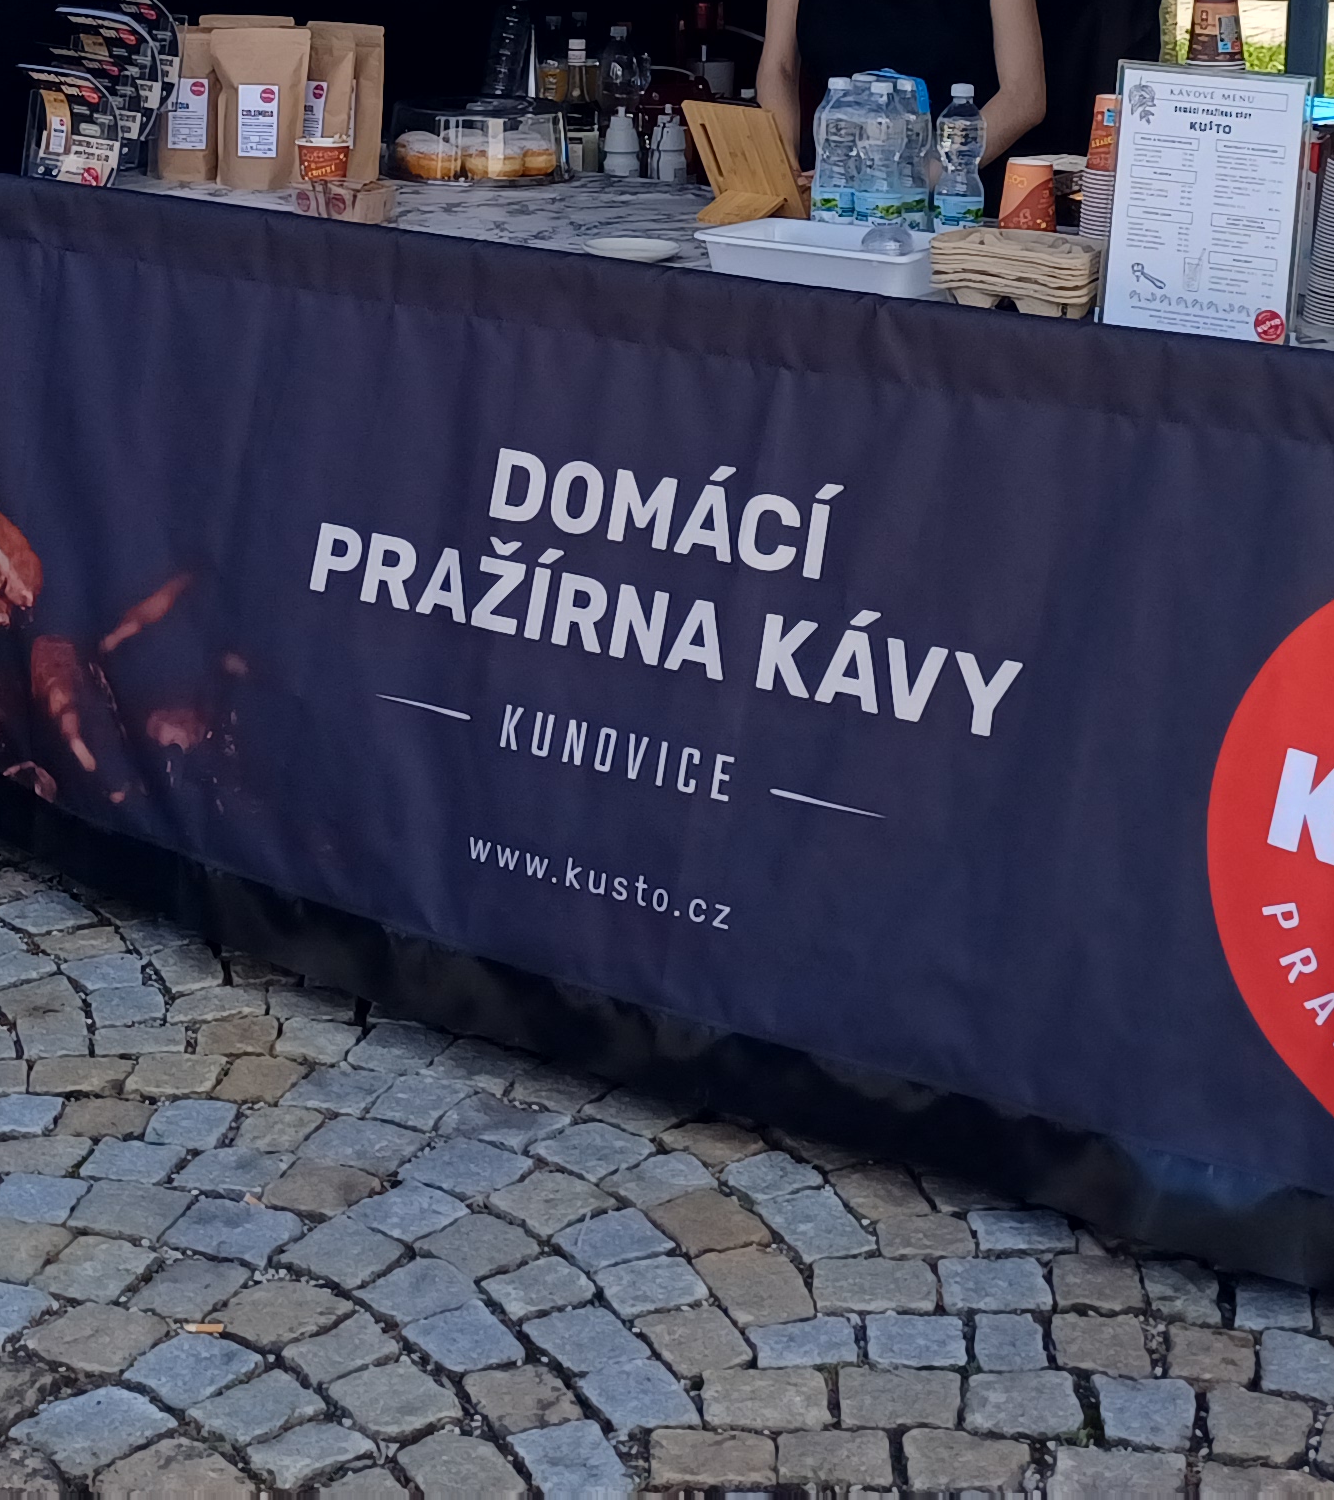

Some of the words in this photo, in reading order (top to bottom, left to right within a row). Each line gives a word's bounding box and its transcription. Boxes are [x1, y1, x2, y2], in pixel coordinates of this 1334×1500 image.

[1170, 88, 1216, 100] KÁVOVÉ
[1221, 93, 1256, 104] MENU
[1189, 120, 1232, 135] KUSTO
[489, 447, 845, 580] DOMÁCÍ
[309, 522, 725, 681] PRAŽÍRNA
[756, 610, 1024, 737] KÁVY
[499, 704, 735, 801] KUNOVICE
[469, 837, 731, 930] www.kusto.cz
